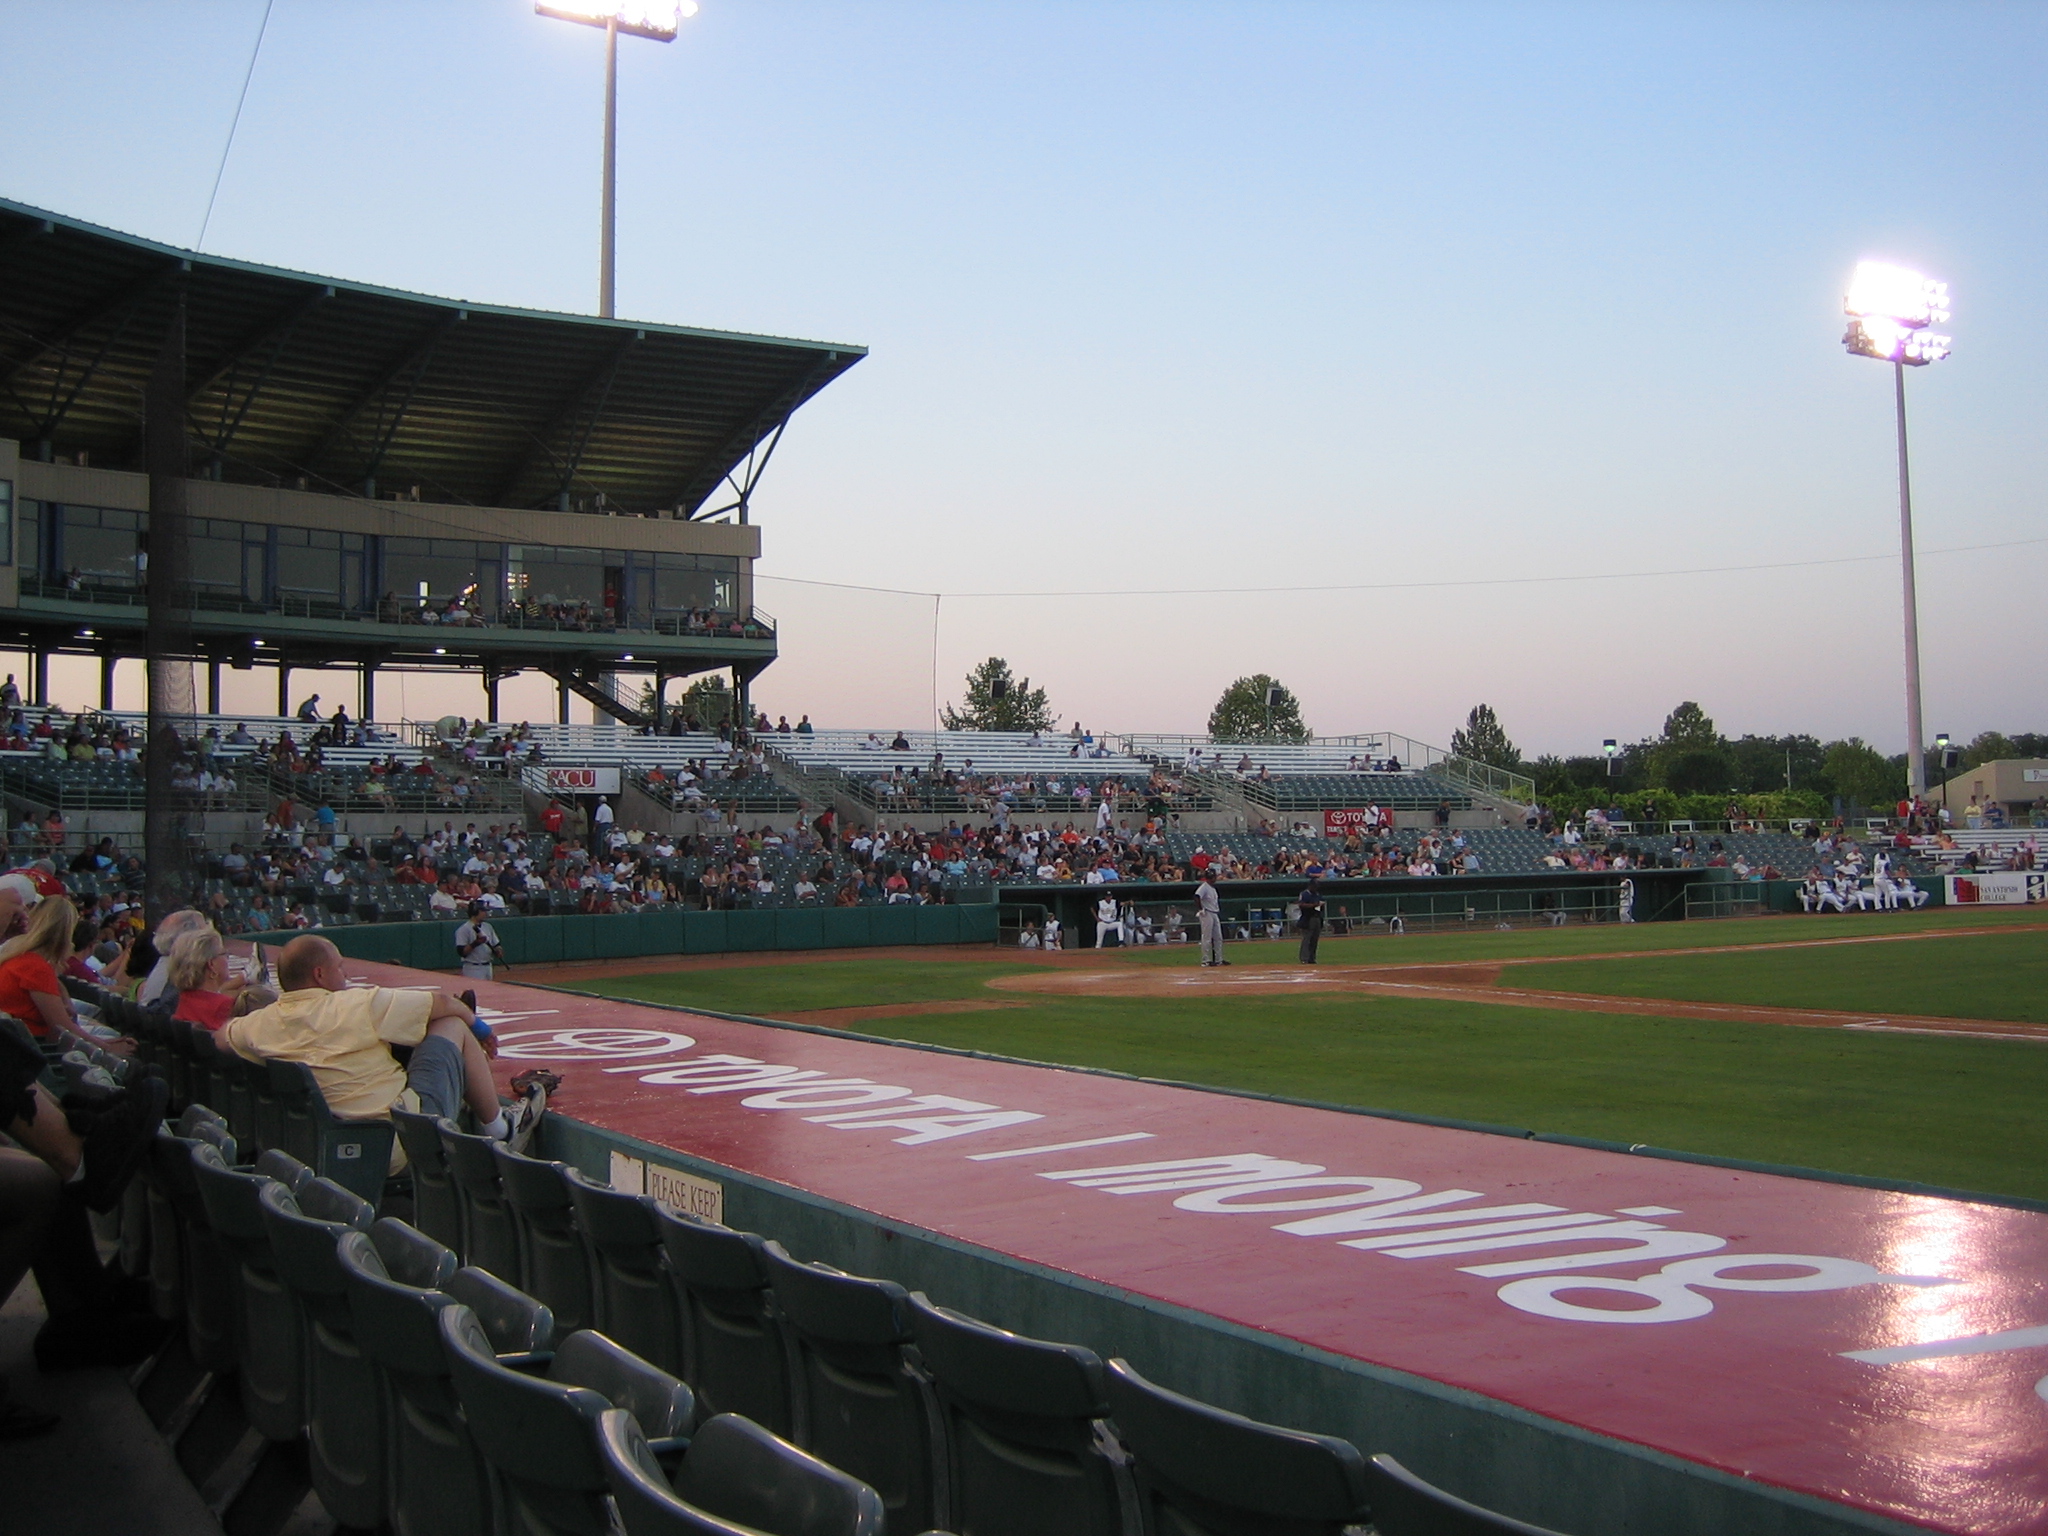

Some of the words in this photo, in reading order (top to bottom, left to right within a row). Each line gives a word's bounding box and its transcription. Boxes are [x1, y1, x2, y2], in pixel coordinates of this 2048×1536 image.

[549, 769, 594, 787] SACU
[602, 1055, 1045, 1145] TOYOTA
[653, 1174, 686, 1209] PLEASE
[691, 1186, 716, 1218] KEEP
[1037, 1152, 1966, 1323] moving
